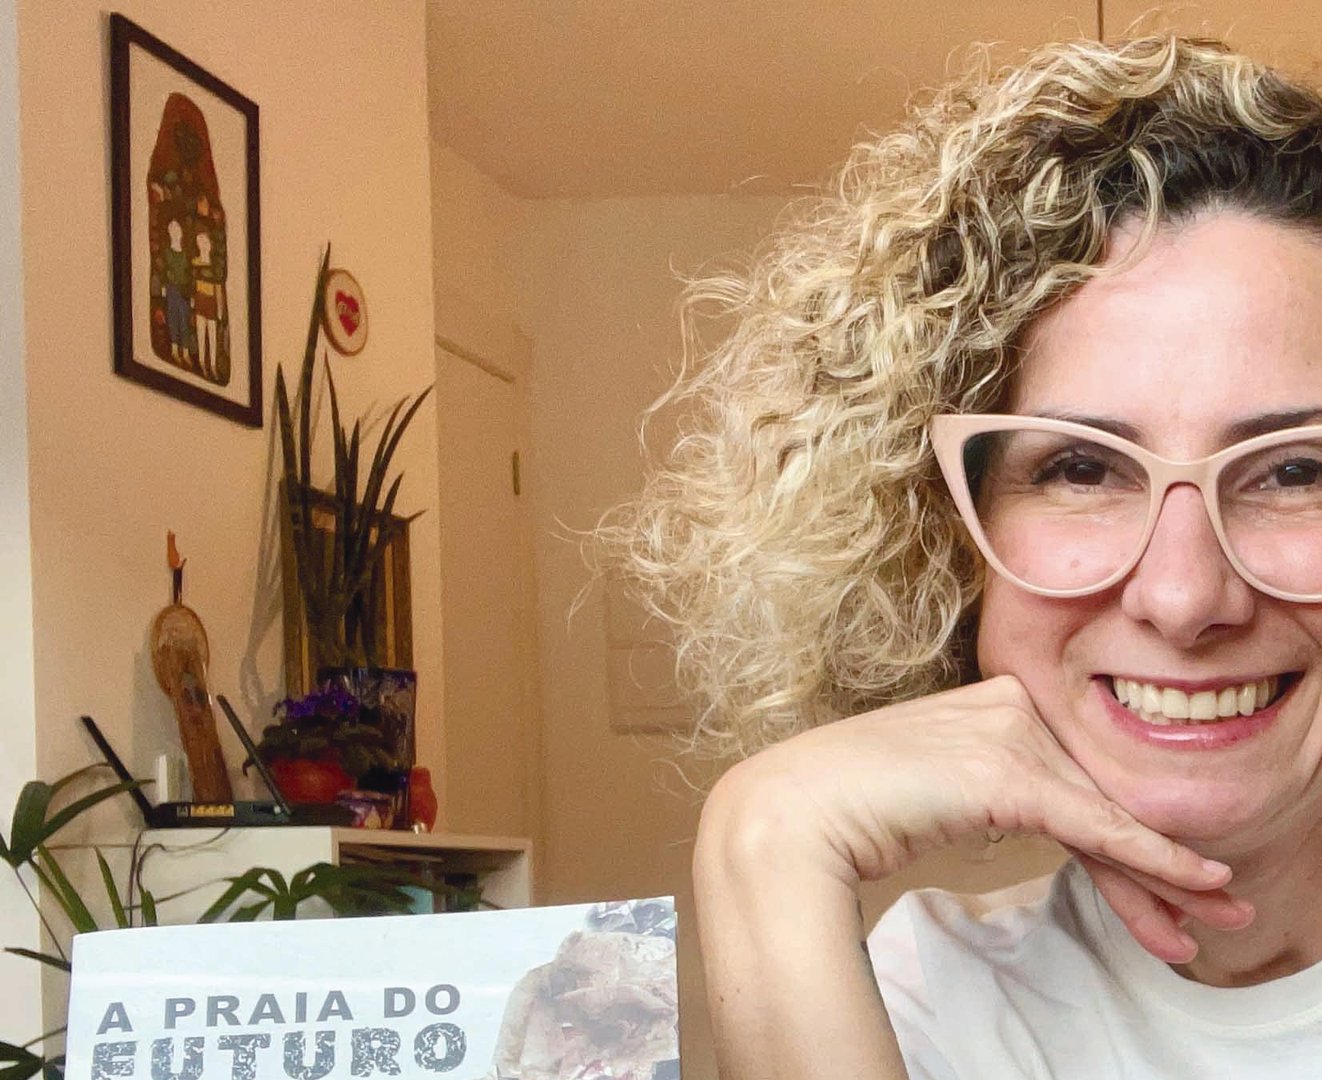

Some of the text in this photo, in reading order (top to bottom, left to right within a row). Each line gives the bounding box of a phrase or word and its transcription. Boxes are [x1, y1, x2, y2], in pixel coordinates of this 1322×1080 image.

[95, 983, 462, 1036] A PRAIA DO
